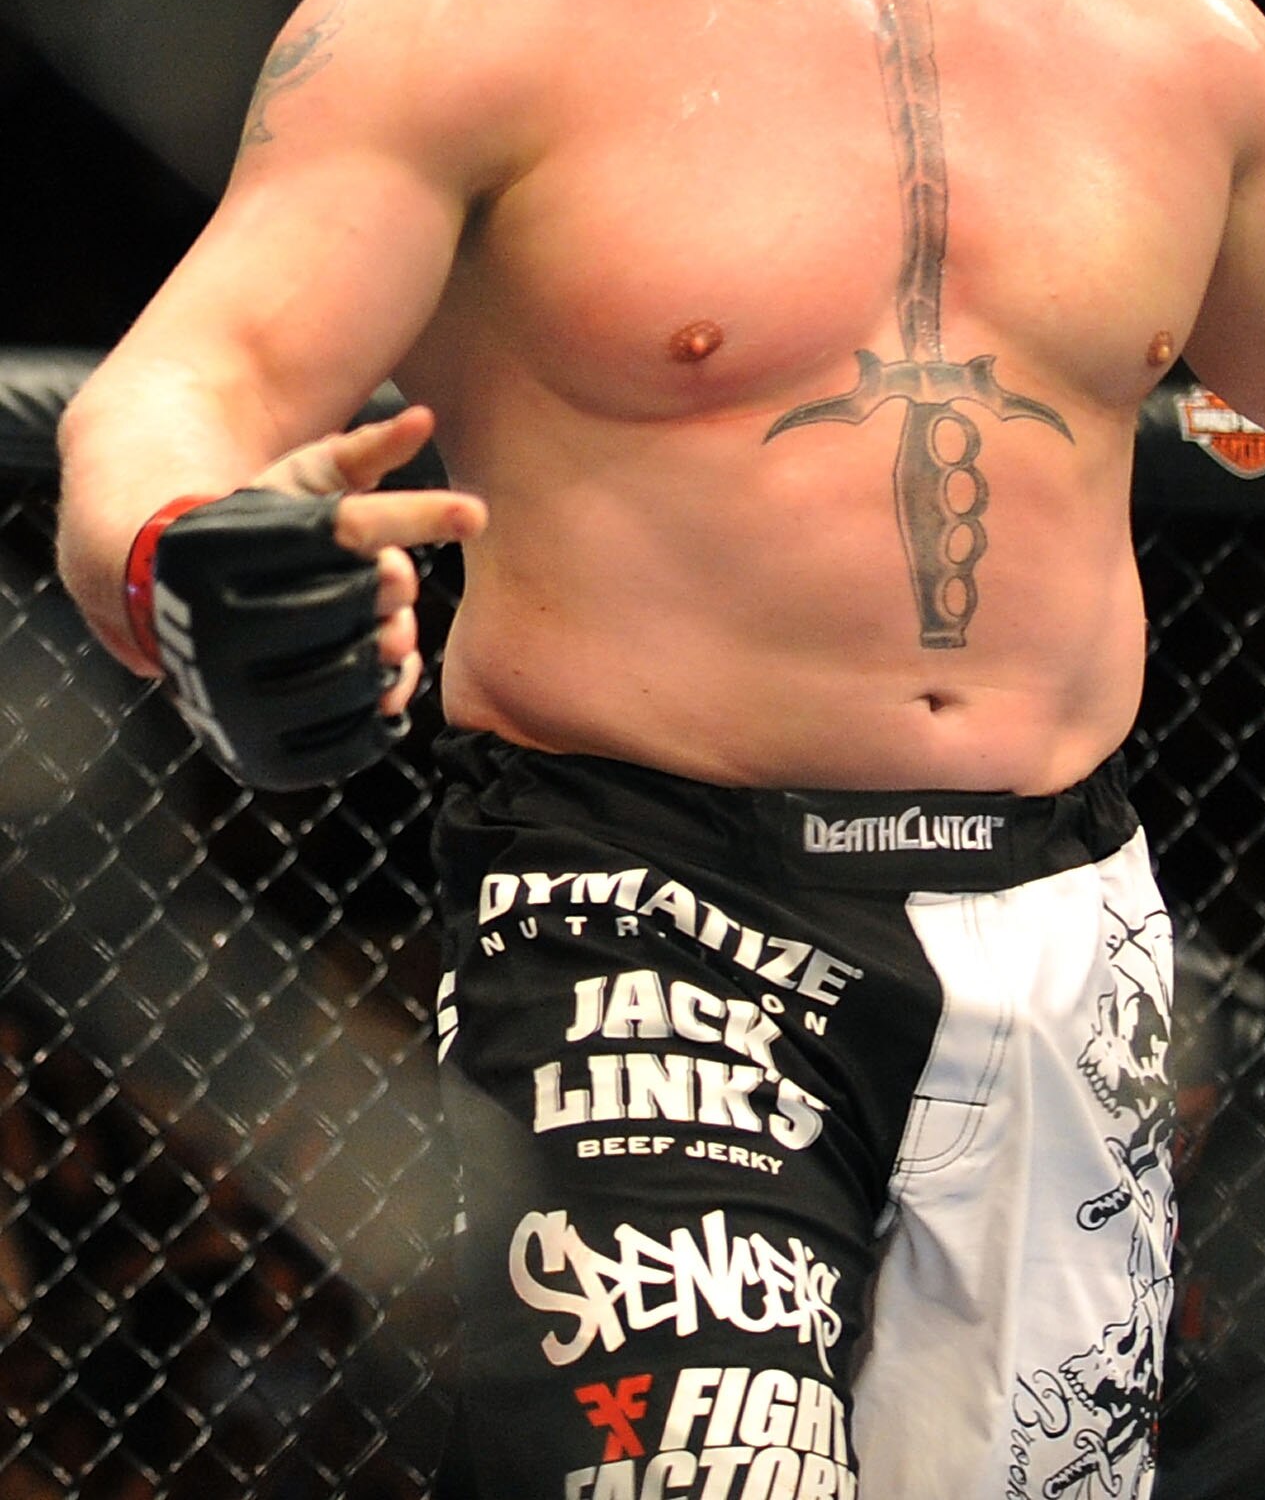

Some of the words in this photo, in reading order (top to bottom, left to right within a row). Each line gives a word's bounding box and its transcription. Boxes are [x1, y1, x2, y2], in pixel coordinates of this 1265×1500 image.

[479, 915, 828, 1036] NUTRON
[565, 969, 782, 1072] JACK
[533, 1053, 831, 1151] LINK'S
[577, 1137, 675, 1158] BEEF
[685, 1140, 783, 1175] JERKY
[658, 1367, 848, 1466] FIGHT
